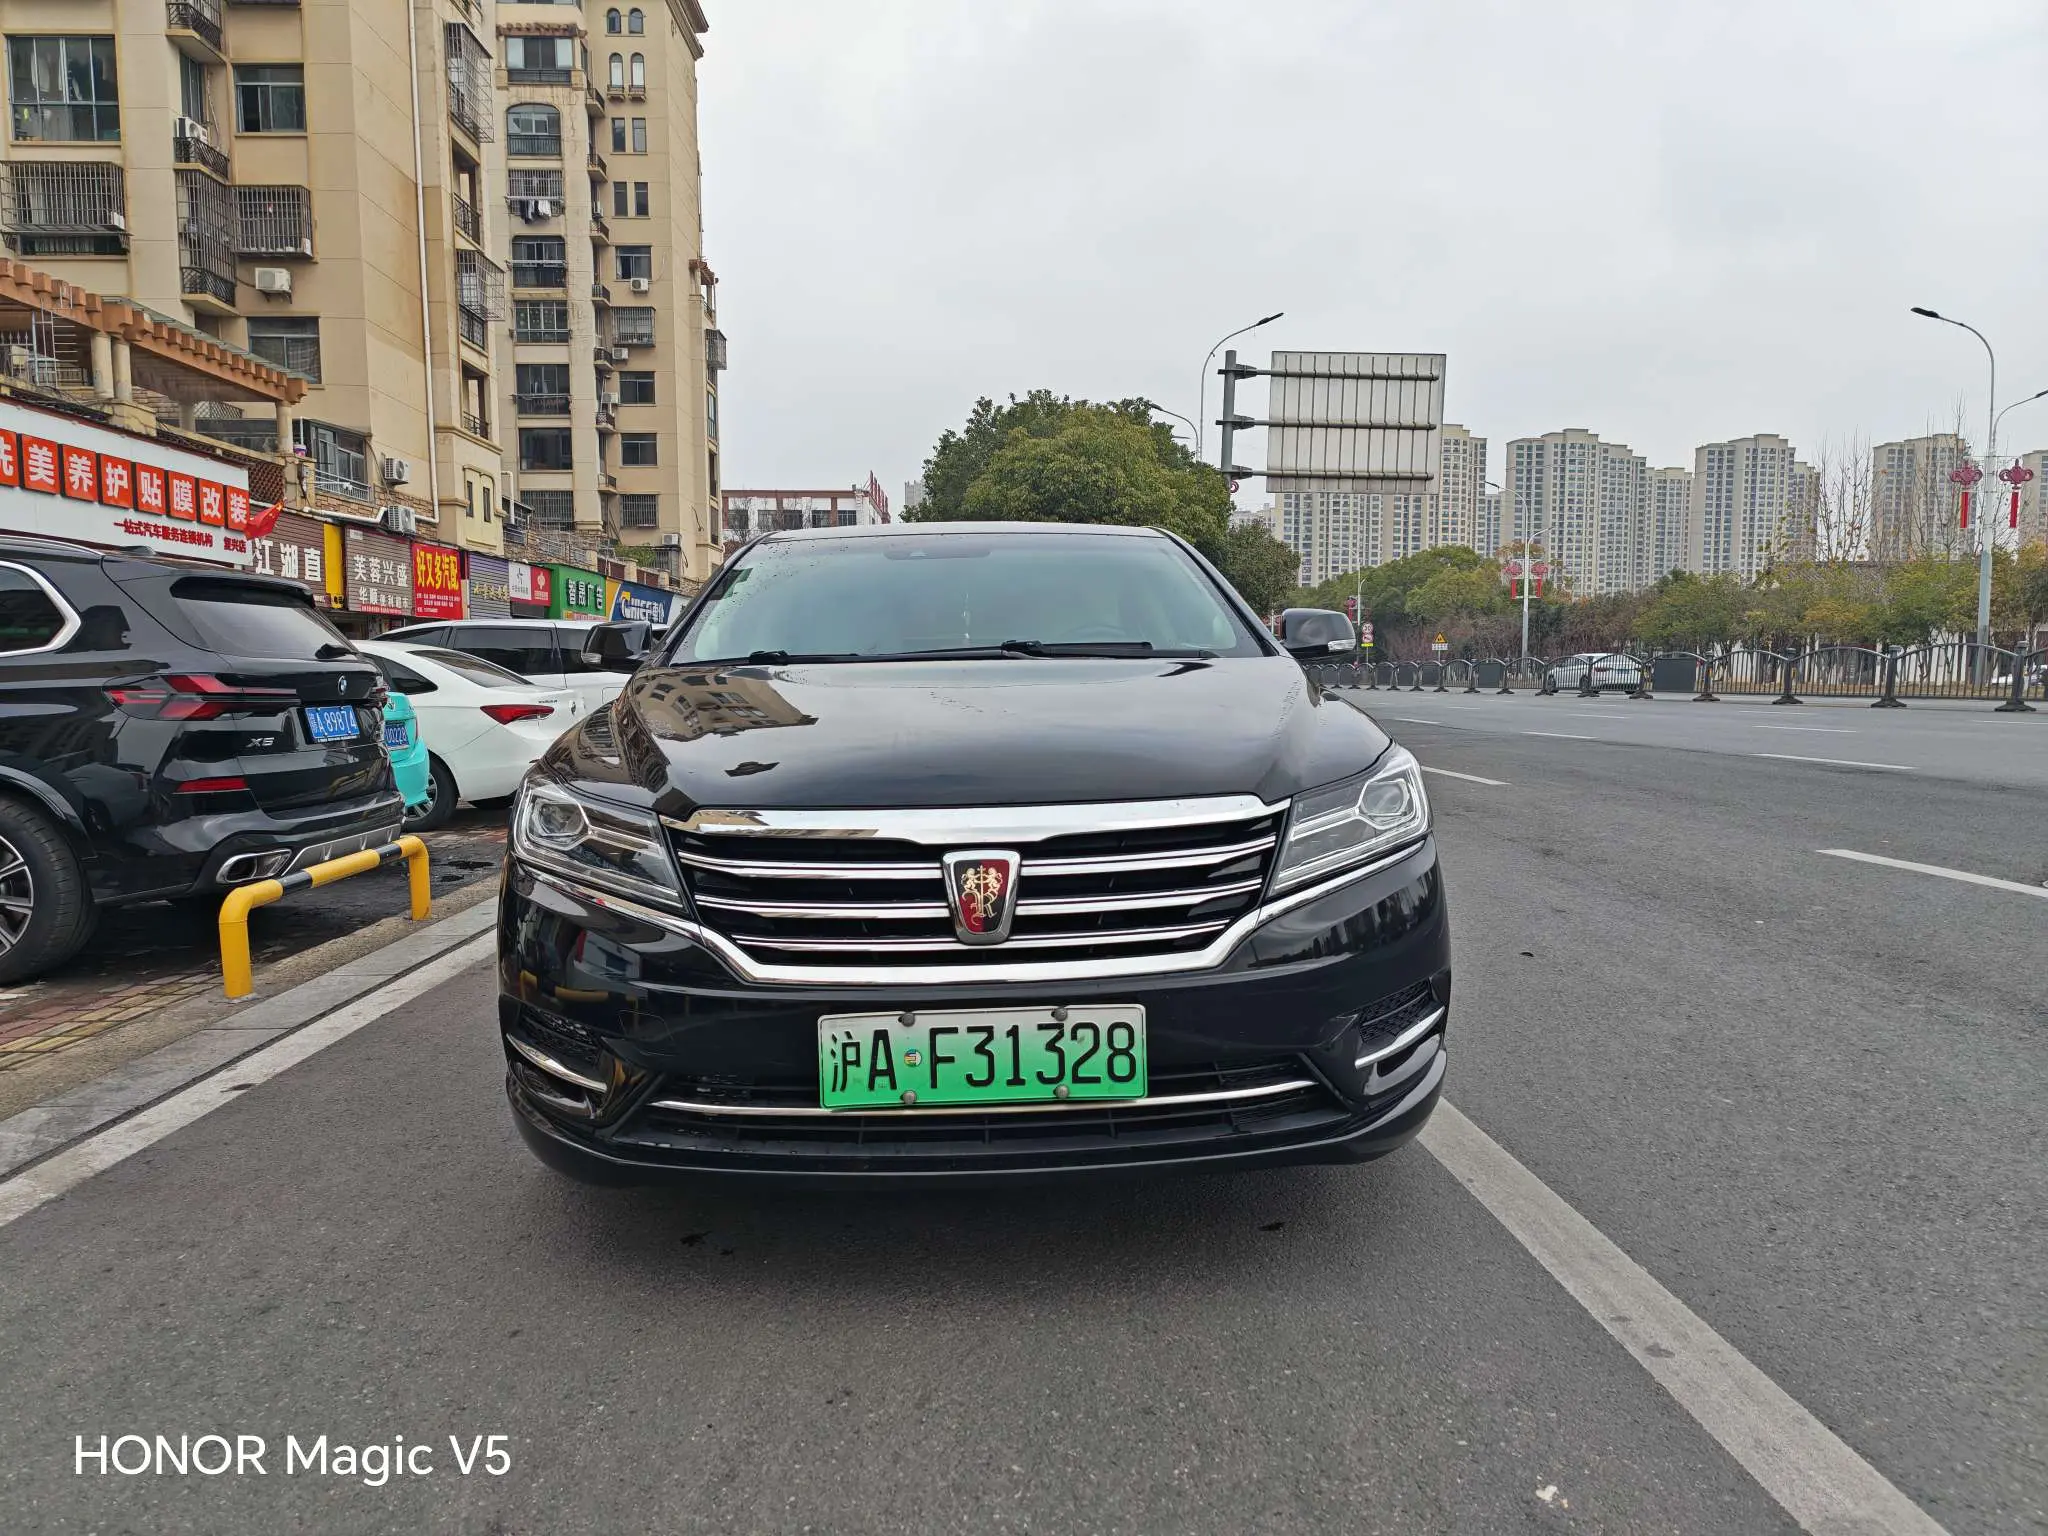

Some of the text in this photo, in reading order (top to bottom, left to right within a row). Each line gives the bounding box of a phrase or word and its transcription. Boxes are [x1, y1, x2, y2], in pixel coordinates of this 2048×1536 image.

[353, 554, 409, 587] 芙蓉兴盛
[416, 548, 459, 590] 好又多汽配
[246, 737, 275, 747] X5
